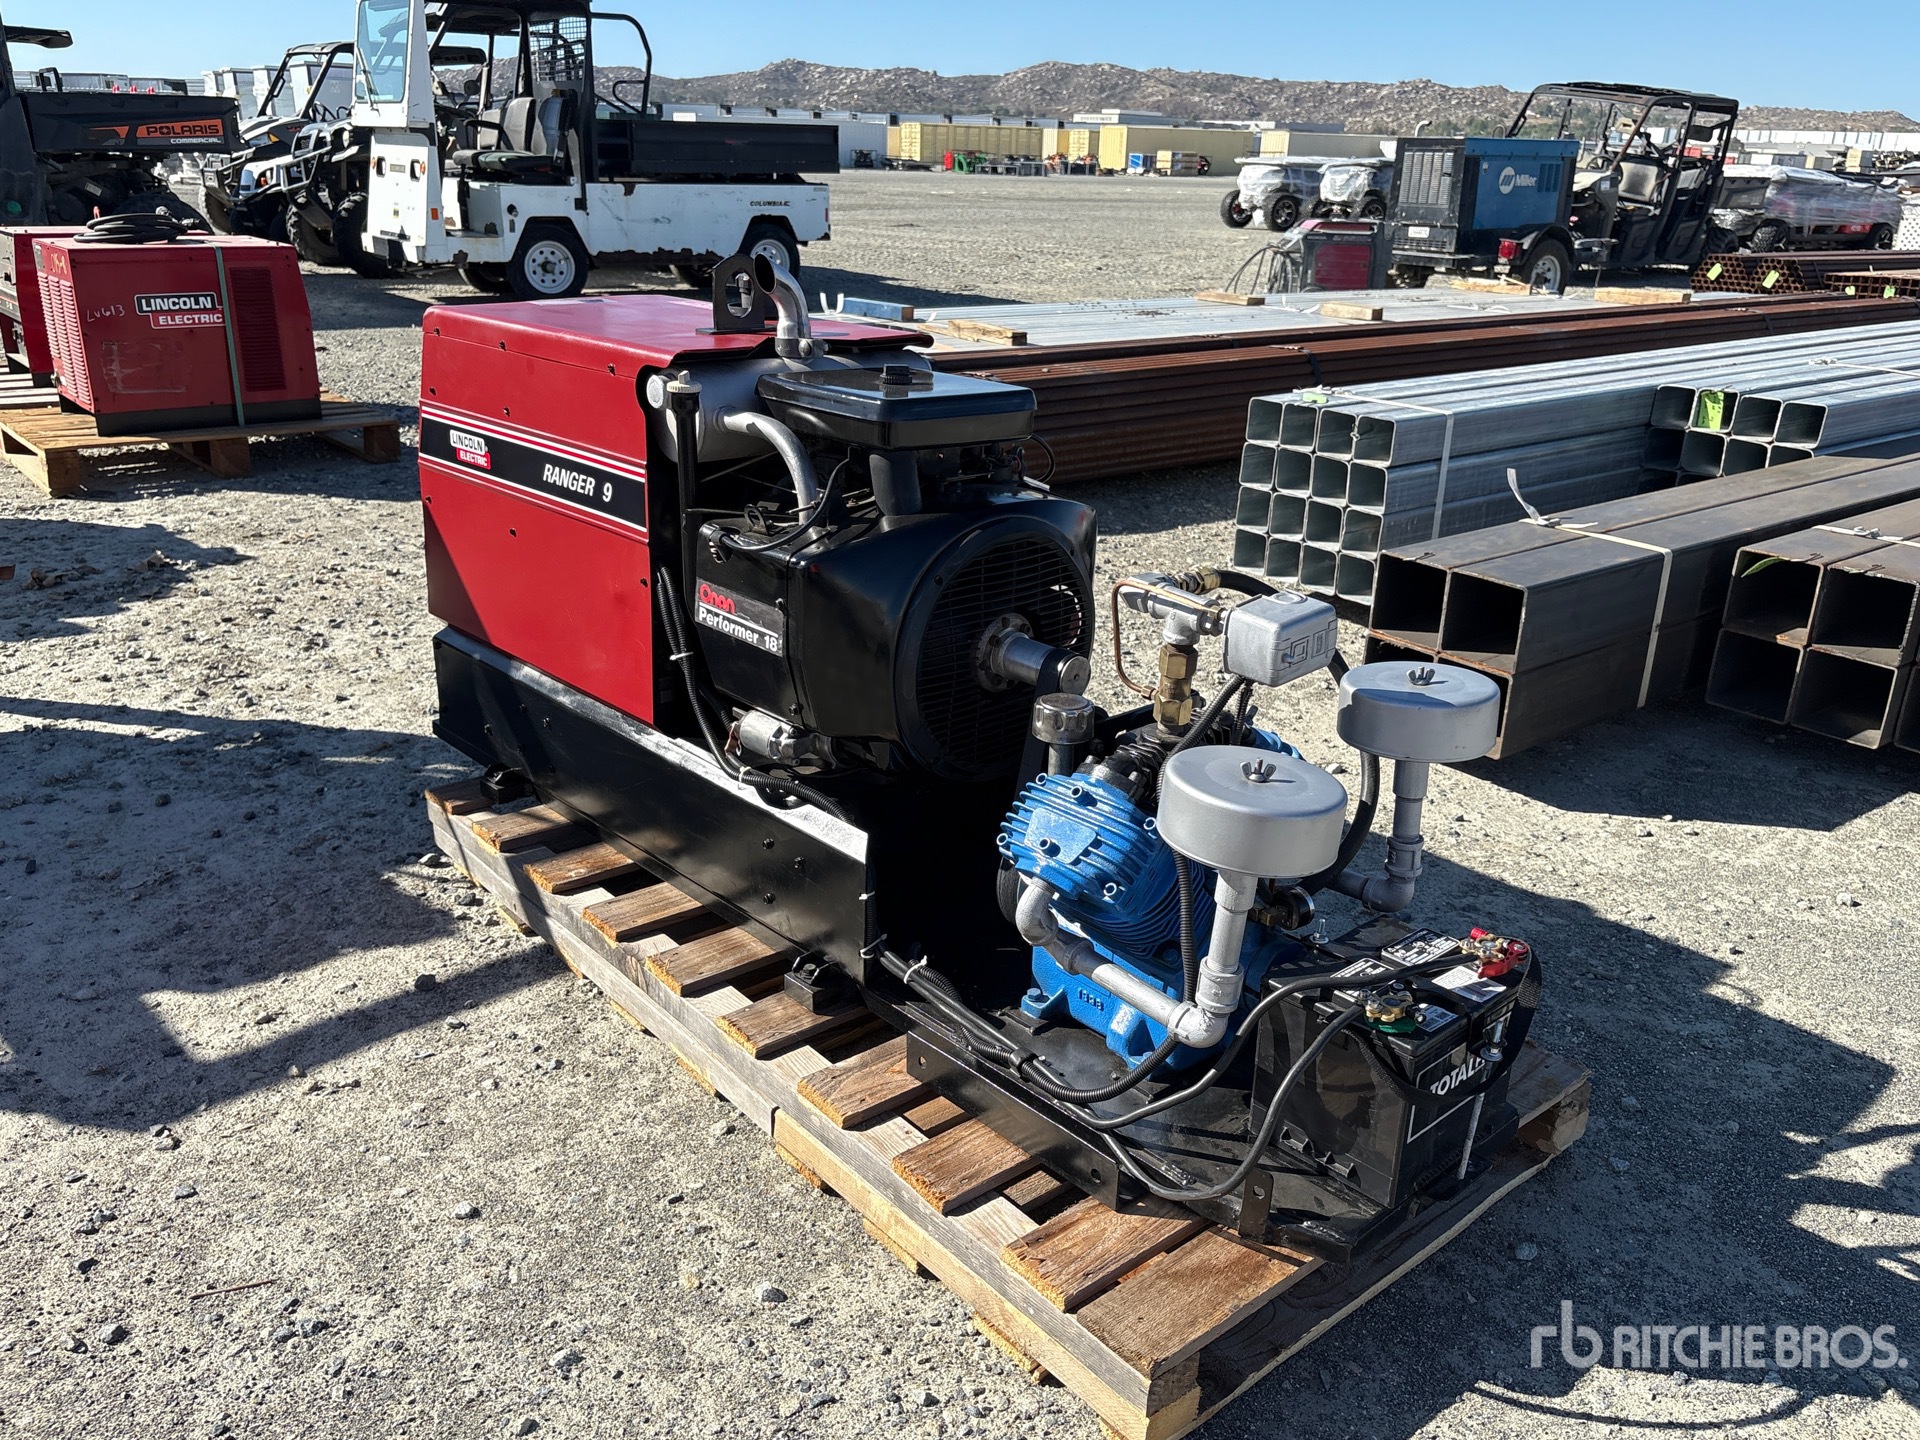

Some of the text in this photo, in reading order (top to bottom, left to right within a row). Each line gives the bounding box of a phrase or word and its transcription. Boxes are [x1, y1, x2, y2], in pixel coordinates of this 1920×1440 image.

[146, 125, 219, 136] POLARIS
[1515, 174, 1537, 187] Miller
[141, 297, 212, 311] LINCOLN
[158, 313, 223, 325] ELECTRIC
[452, 433, 483, 452] LINCOLN
[460, 450, 488, 467] ELECTRIC
[543, 463, 613, 502] RANGER 9
[699, 583, 735, 614] Onan
[699, 606, 778, 652] Performer 18
